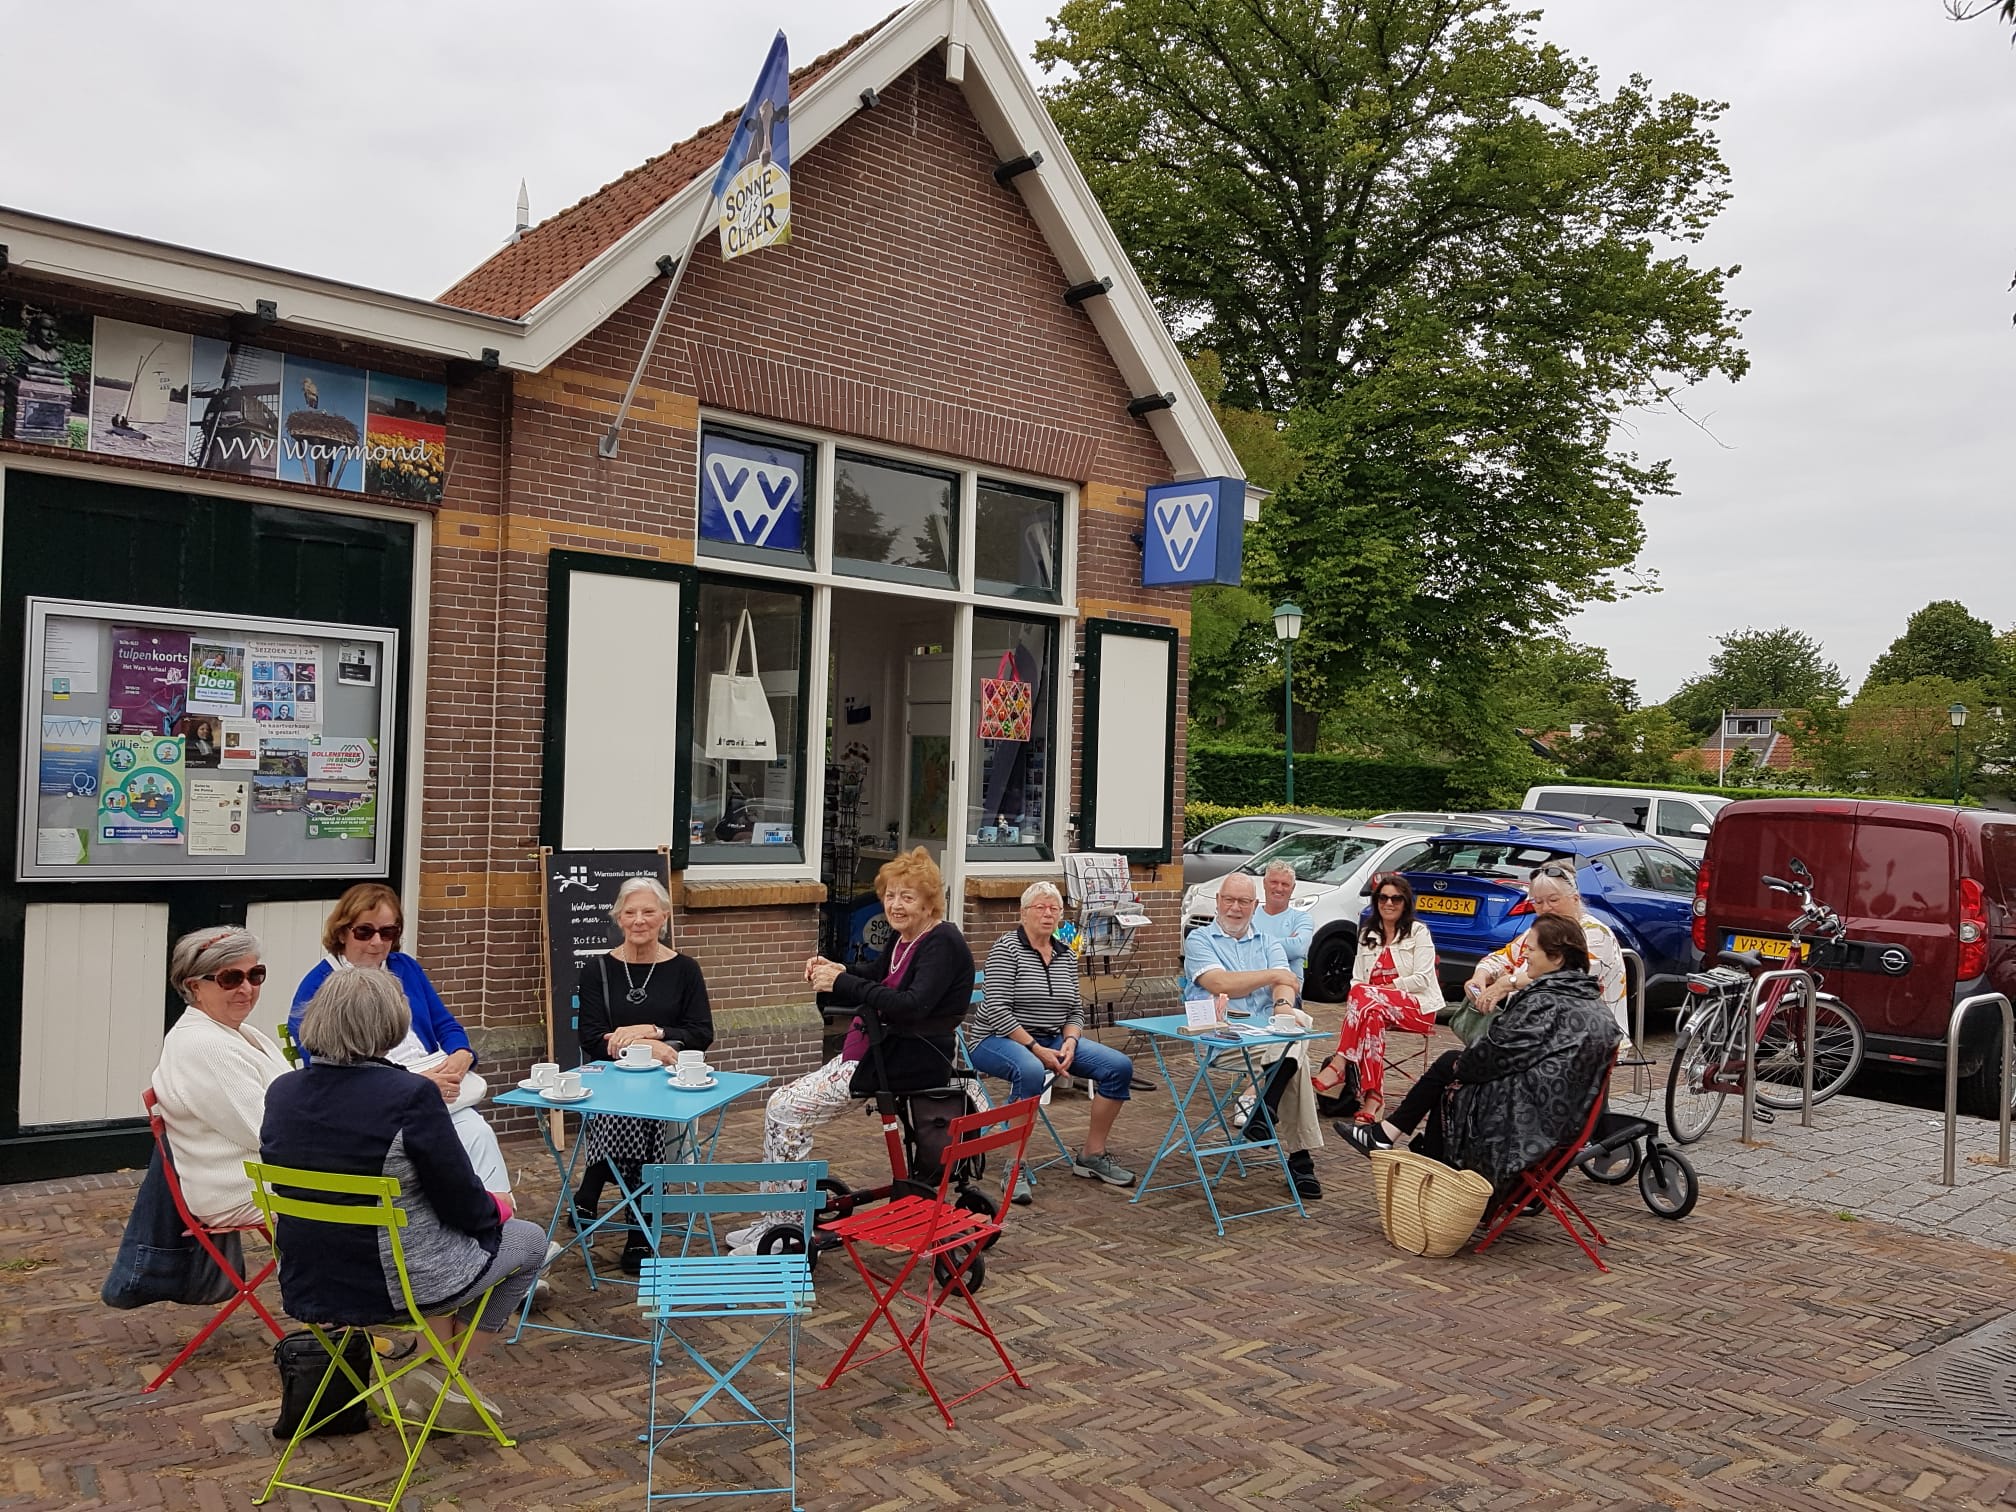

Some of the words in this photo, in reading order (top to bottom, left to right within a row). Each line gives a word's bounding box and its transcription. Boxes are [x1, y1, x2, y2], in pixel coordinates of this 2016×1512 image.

[725, 170, 773, 222] SONNE
[728, 203, 777, 252] CLAER
[282, 438, 433, 462] Warmond
[119, 647, 188, 663] tulpenkoorts
[198, 675, 235, 689] Doen
[111, 739, 126, 748] Wil
[594, 870, 625, 878] Warmond
[643, 870, 658, 878] Kaag
[1419, 897, 1471, 912] SG-403-K
[573, 936, 607, 944] Koffie
[1740, 938, 1792, 954] VRX-17-
